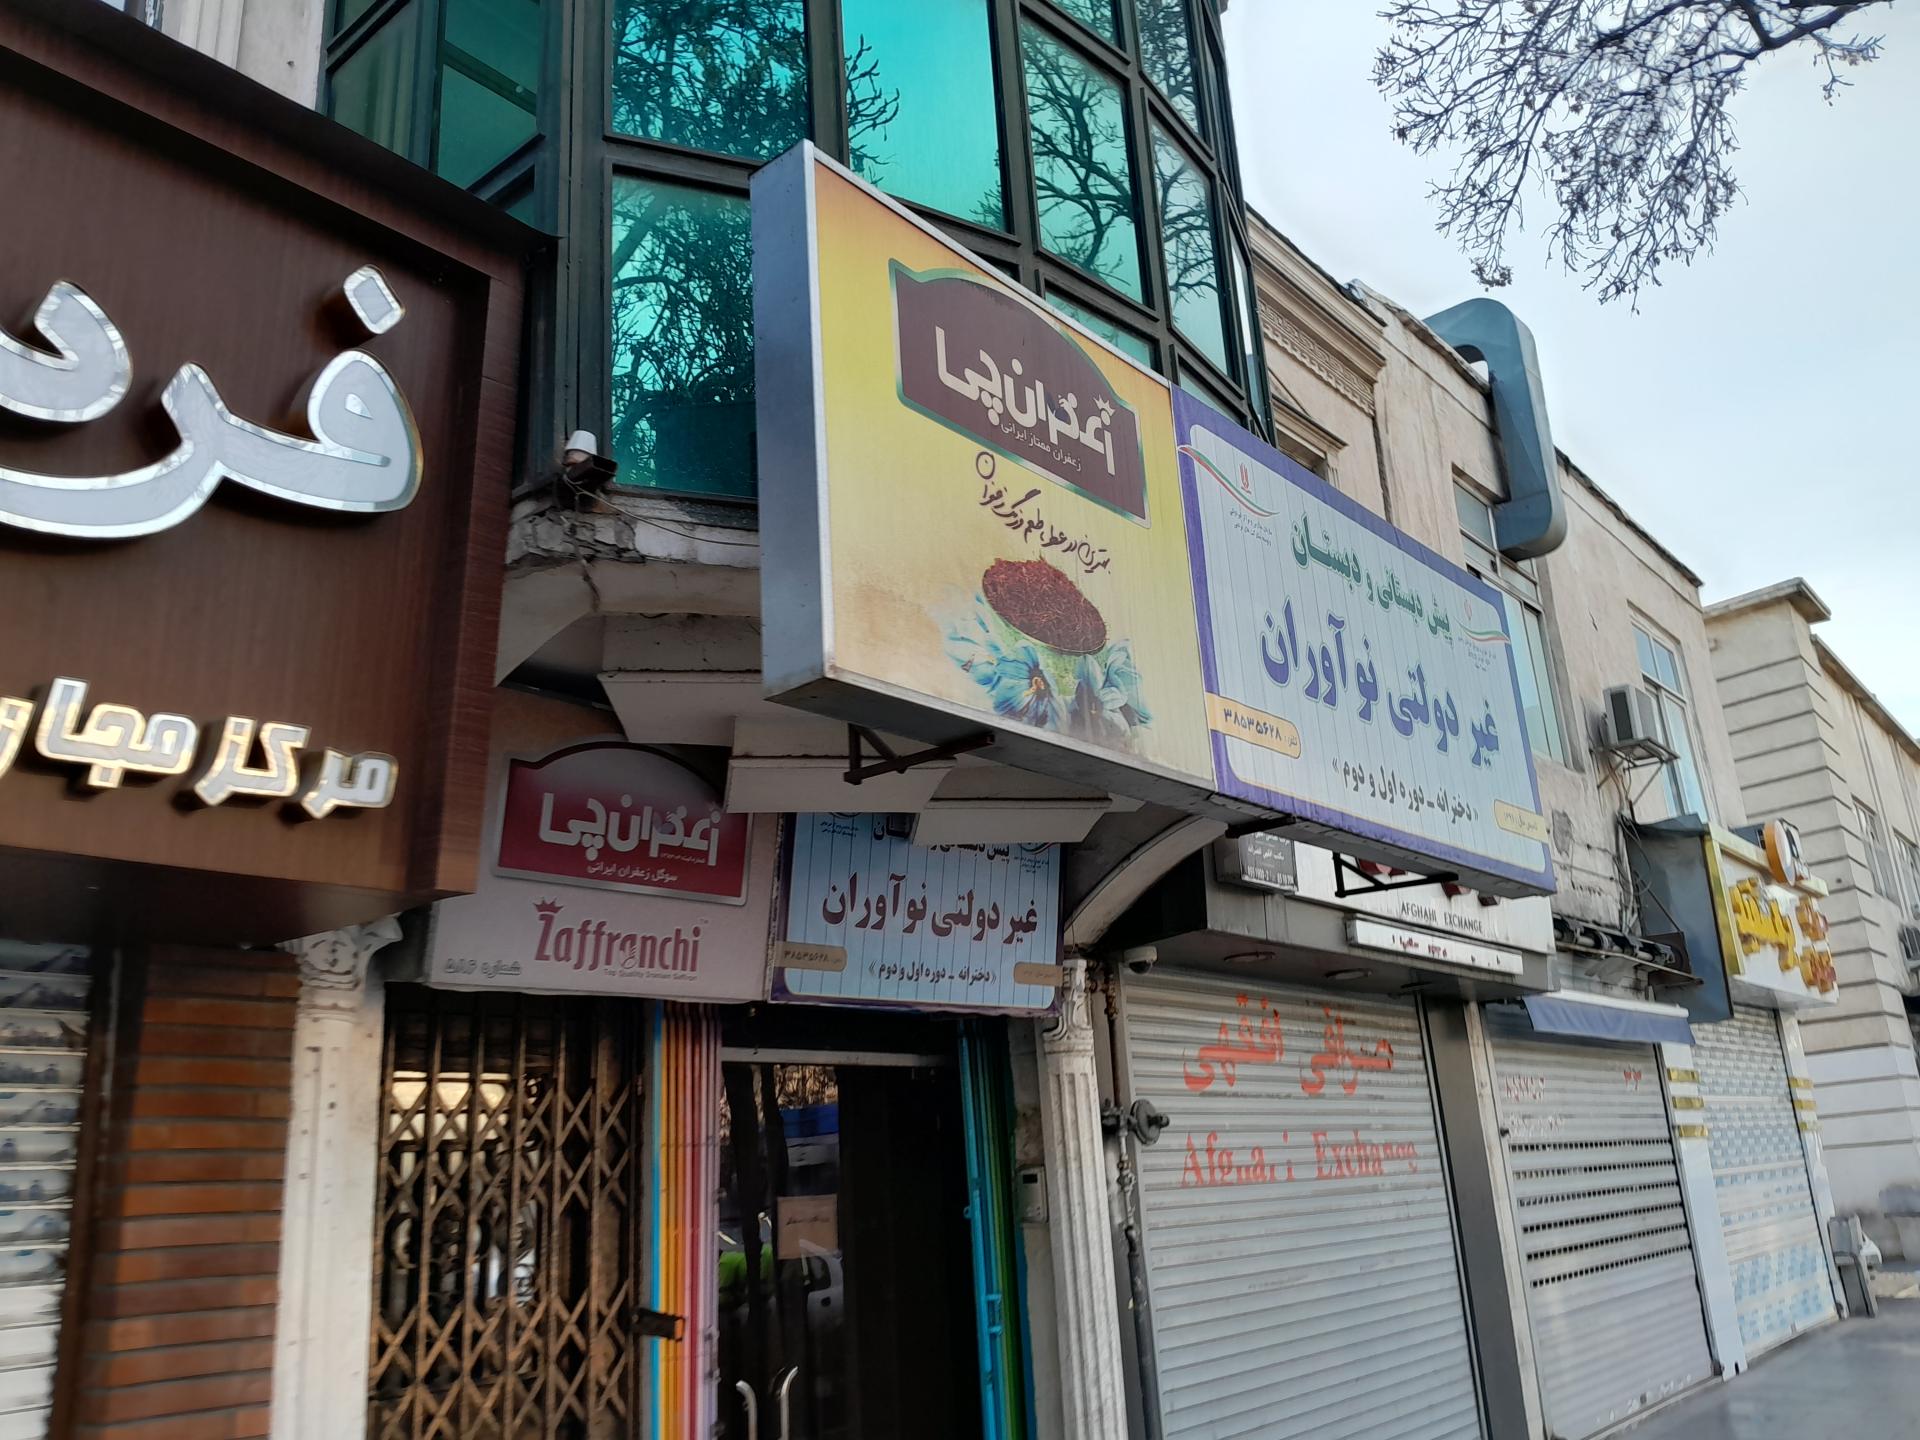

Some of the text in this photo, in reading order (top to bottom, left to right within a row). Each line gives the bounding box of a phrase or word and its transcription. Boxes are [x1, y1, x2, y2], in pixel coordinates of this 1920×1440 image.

[1000, 422, 1082, 472] زعفران ممتاز ایرانی
[1024, 508, 1044, 543] طعم
[1292, 516, 1362, 592] دبستان
[1366, 573, 1374, 602] و
[1377, 569, 1423, 624] دبستانی
[1428, 597, 1453, 641] پیش
[1388, 664, 1459, 752] دولتی
[1472, 700, 1499, 766] غیر
[195, 716, 399, 819] مرکز
[1369, 773, 1375, 797] و
[1379, 766, 1397, 804] اول
[587, 862, 616, 876] ایرانی
[618, 866, 650, 880] زعفران
[931, 889, 1000, 941] دولتی
[1003, 900, 1037, 944] غیر
[1444, 912, 1483, 932] EXCHANGE
[534, 913, 701, 972] Zaffranchi
[906, 961, 924, 982] اول
